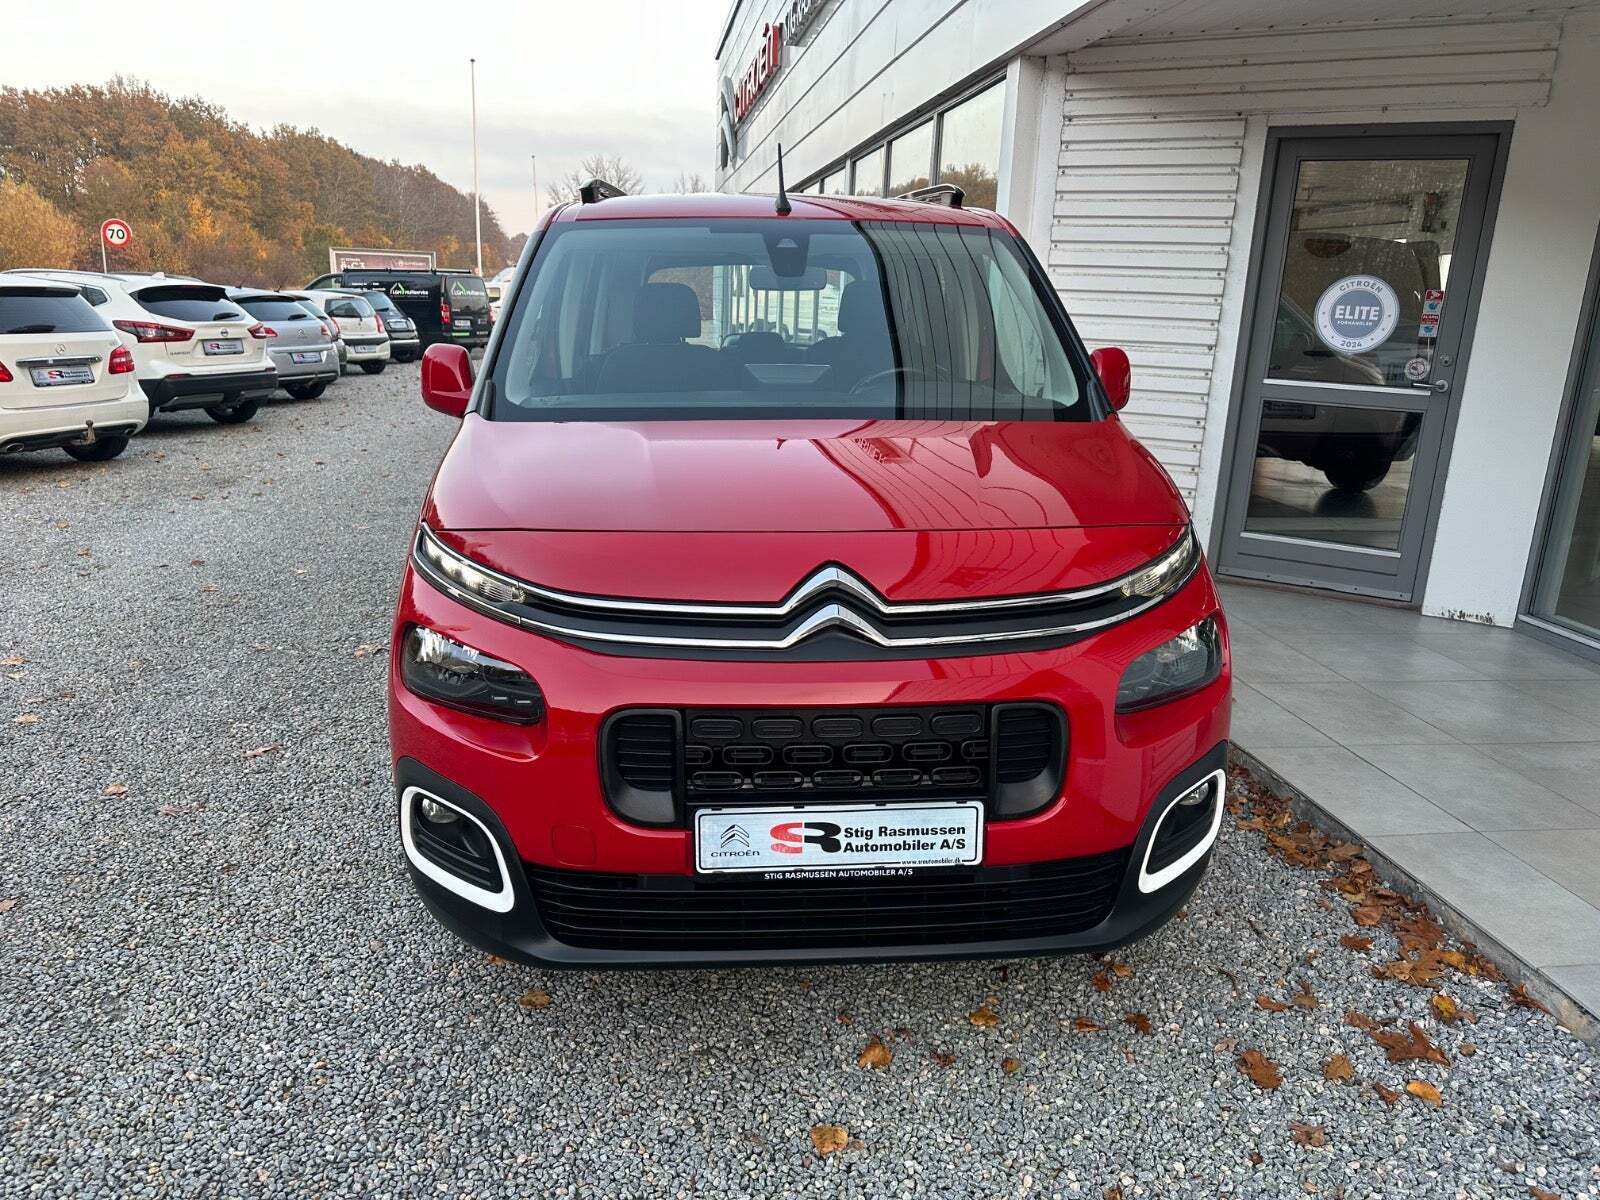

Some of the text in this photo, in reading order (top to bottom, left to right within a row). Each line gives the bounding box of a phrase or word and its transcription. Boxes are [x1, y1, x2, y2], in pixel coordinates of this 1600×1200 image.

[108, 228, 125, 240] 70
[1339, 279, 1383, 294] CITROËN
[1335, 305, 1380, 321] ELITE
[1340, 340, 1362, 348] 2024
[843, 825, 966, 840] Stig Rasmussen
[843, 839, 966, 854] Automobiler A/S
[764, 868, 913, 880] STIG RASMUSSEN AUTOMOBILER A/S
